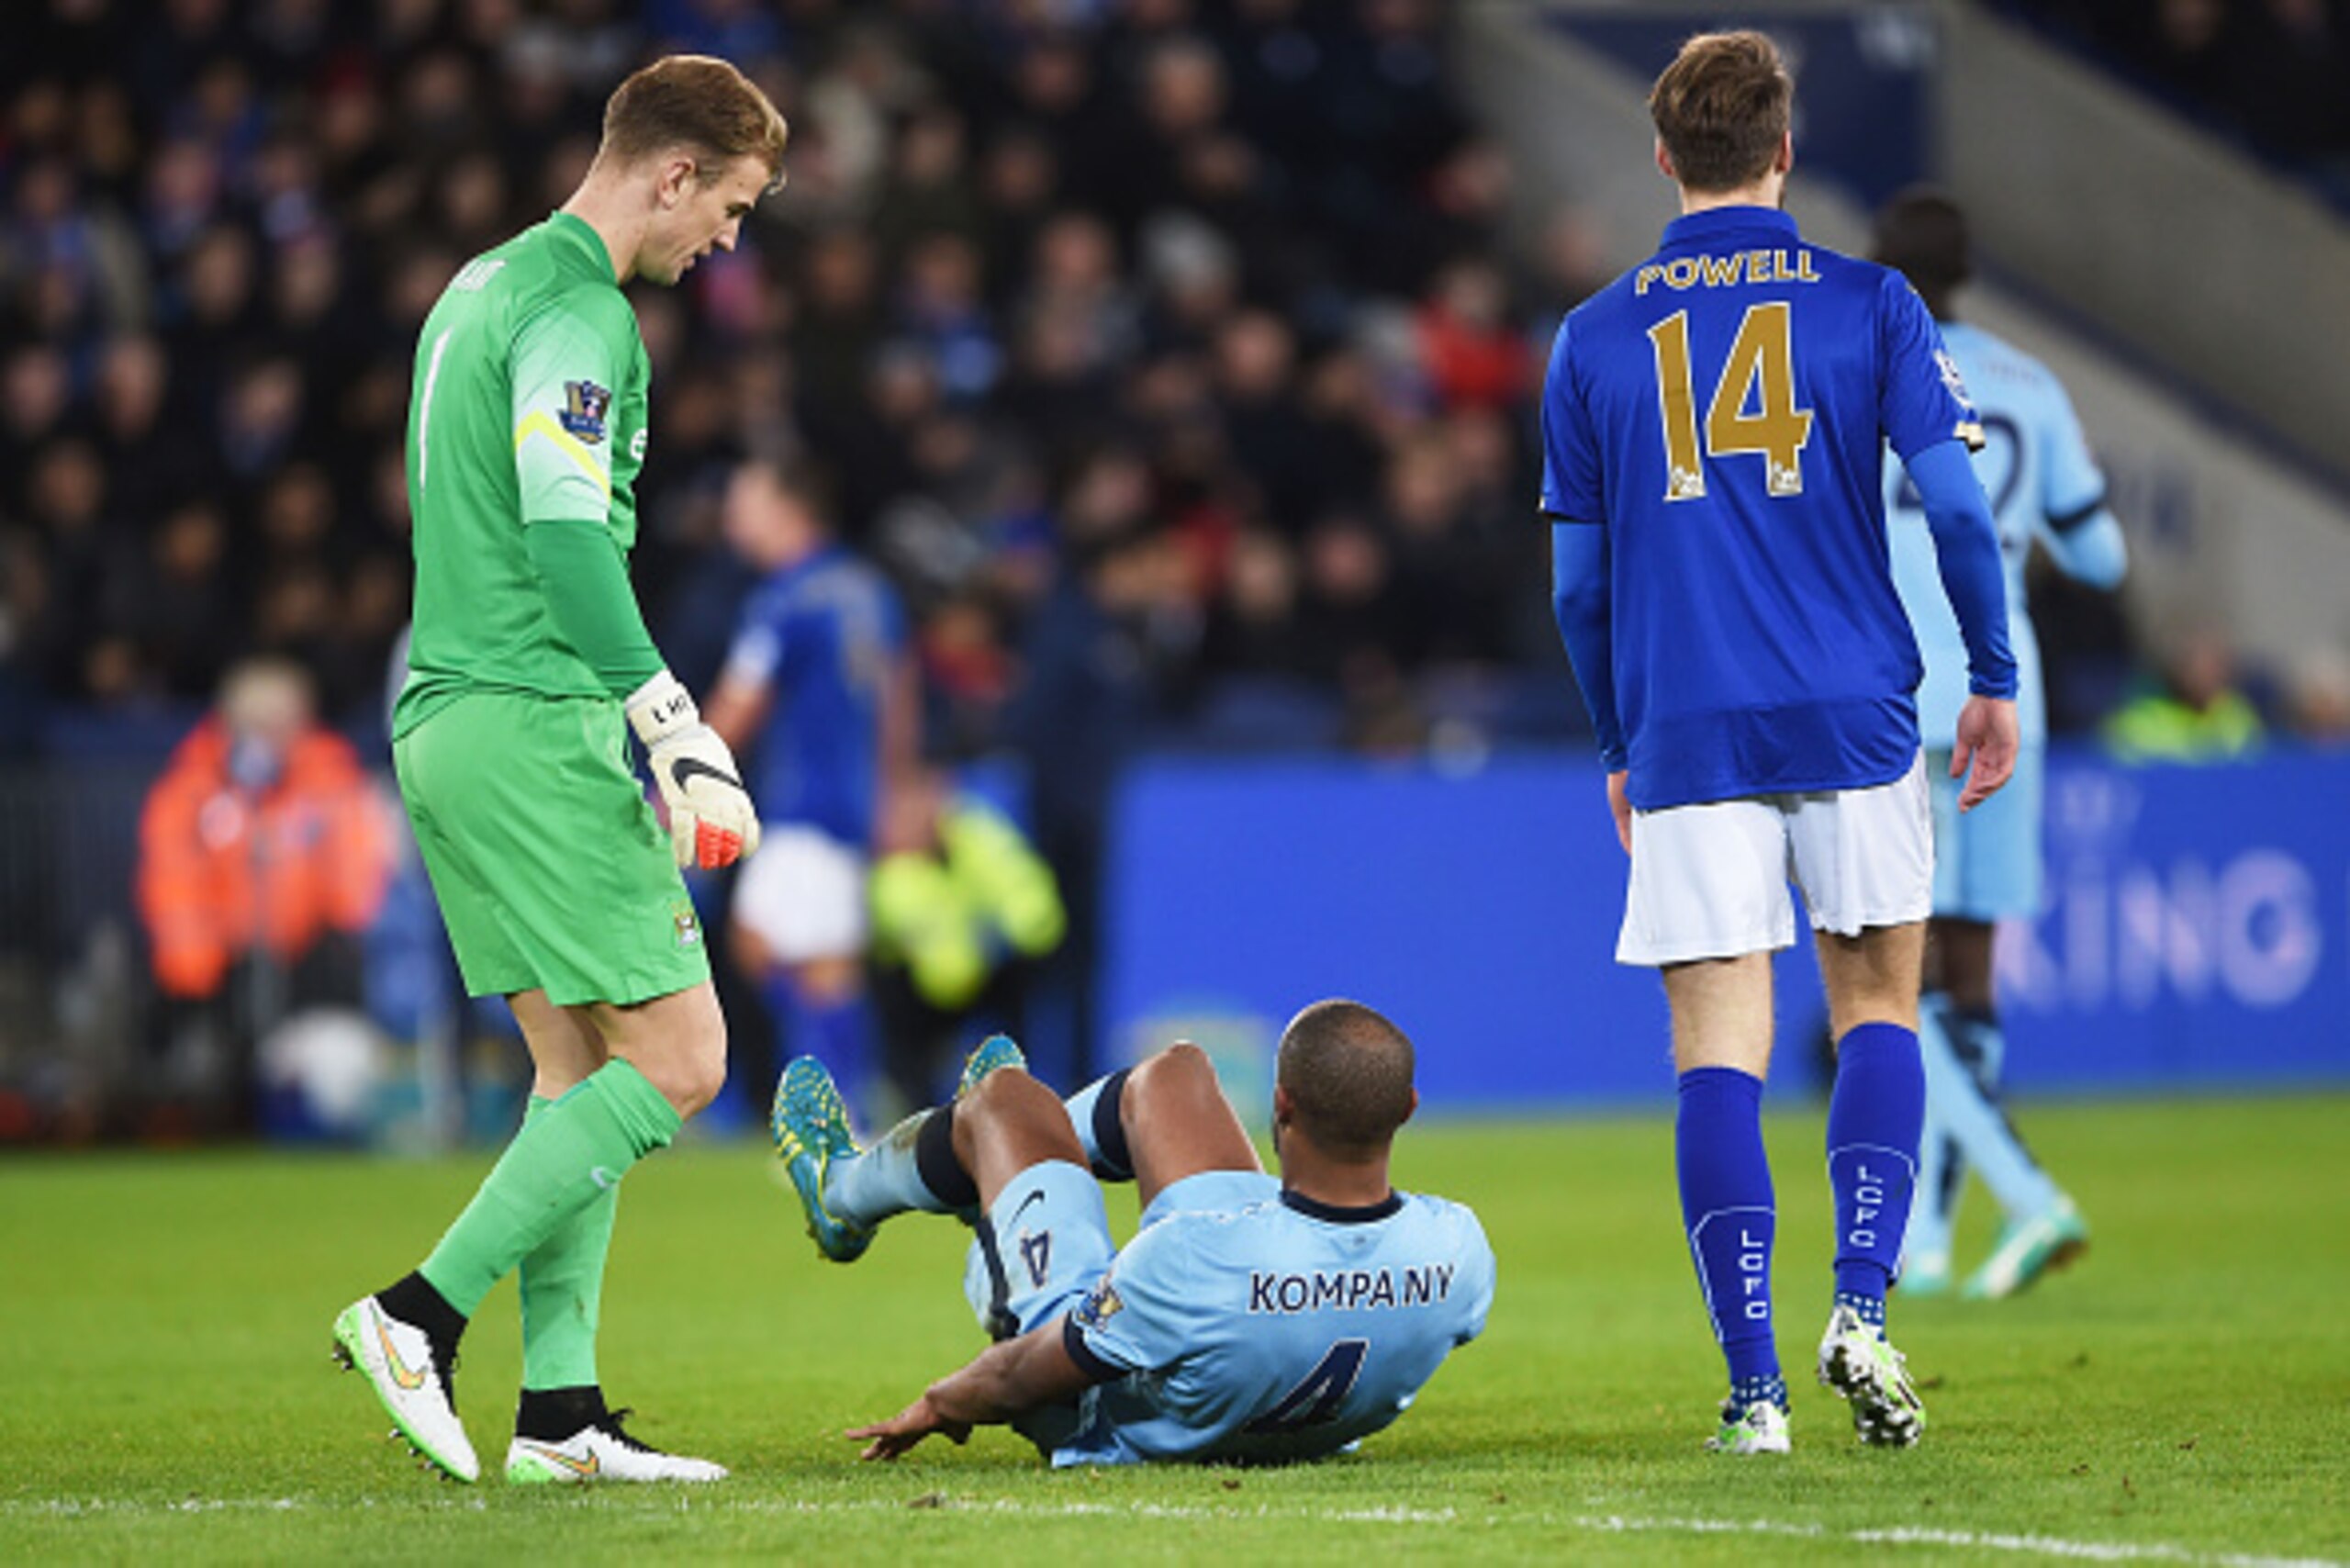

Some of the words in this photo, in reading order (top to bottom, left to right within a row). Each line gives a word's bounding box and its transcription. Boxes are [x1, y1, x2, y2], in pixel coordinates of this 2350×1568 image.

[1635, 248, 1821, 296] POWELL
[1647, 300, 1815, 502] 14
[1848, 1164, 1884, 1249] LCFC
[1248, 1261, 1455, 1314] KOMPANY
[1738, 1228, 1769, 1320] LCFC
[1240, 1337, 1371, 1434] 4
